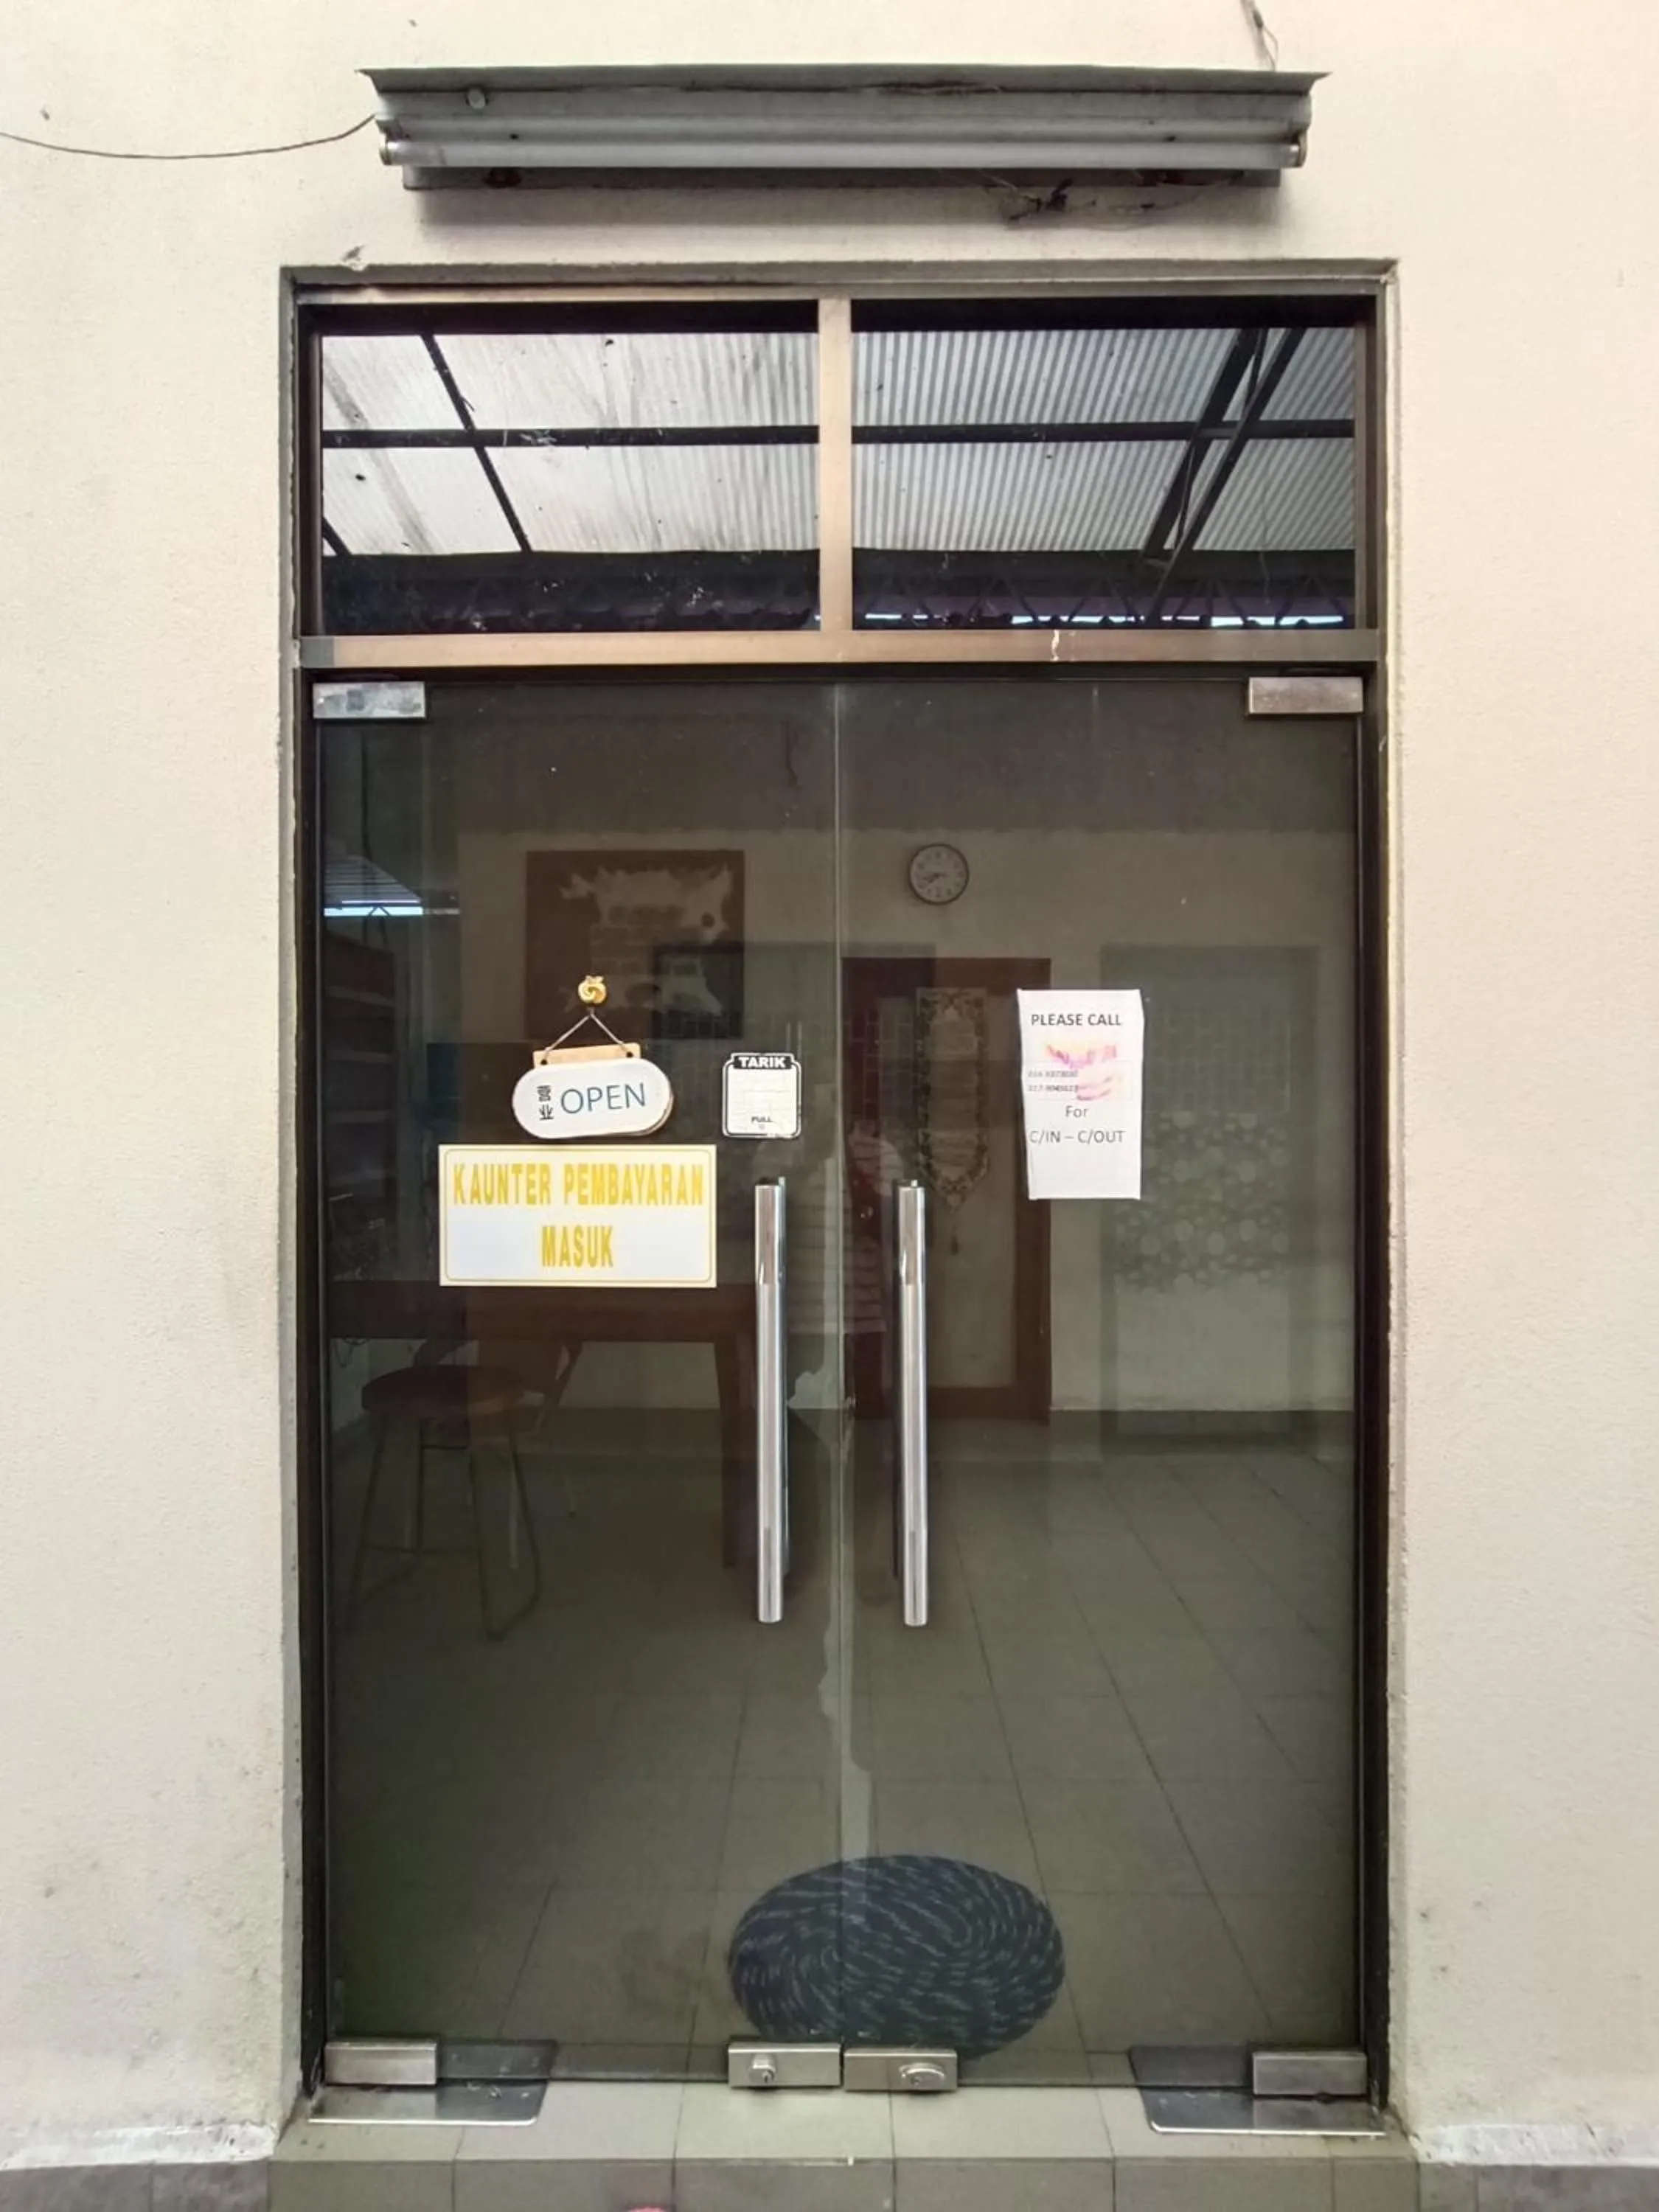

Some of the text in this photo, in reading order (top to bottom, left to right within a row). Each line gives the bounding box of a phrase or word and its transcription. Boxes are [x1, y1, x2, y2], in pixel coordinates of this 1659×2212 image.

[1032, 1013, 1121, 1026] PLEASE CALL
[738, 1057, 786, 1068] TARIK
[560, 1082, 646, 1114] OPEN
[1065, 1105, 1088, 1118] For
[1029, 1130, 1061, 1144] C/IN
[1077, 1130, 1126, 1144] C/OUT
[453, 1163, 703, 1206] KAUNTER PEMBAYARAN
[541, 1225, 613, 1267] MASUK
